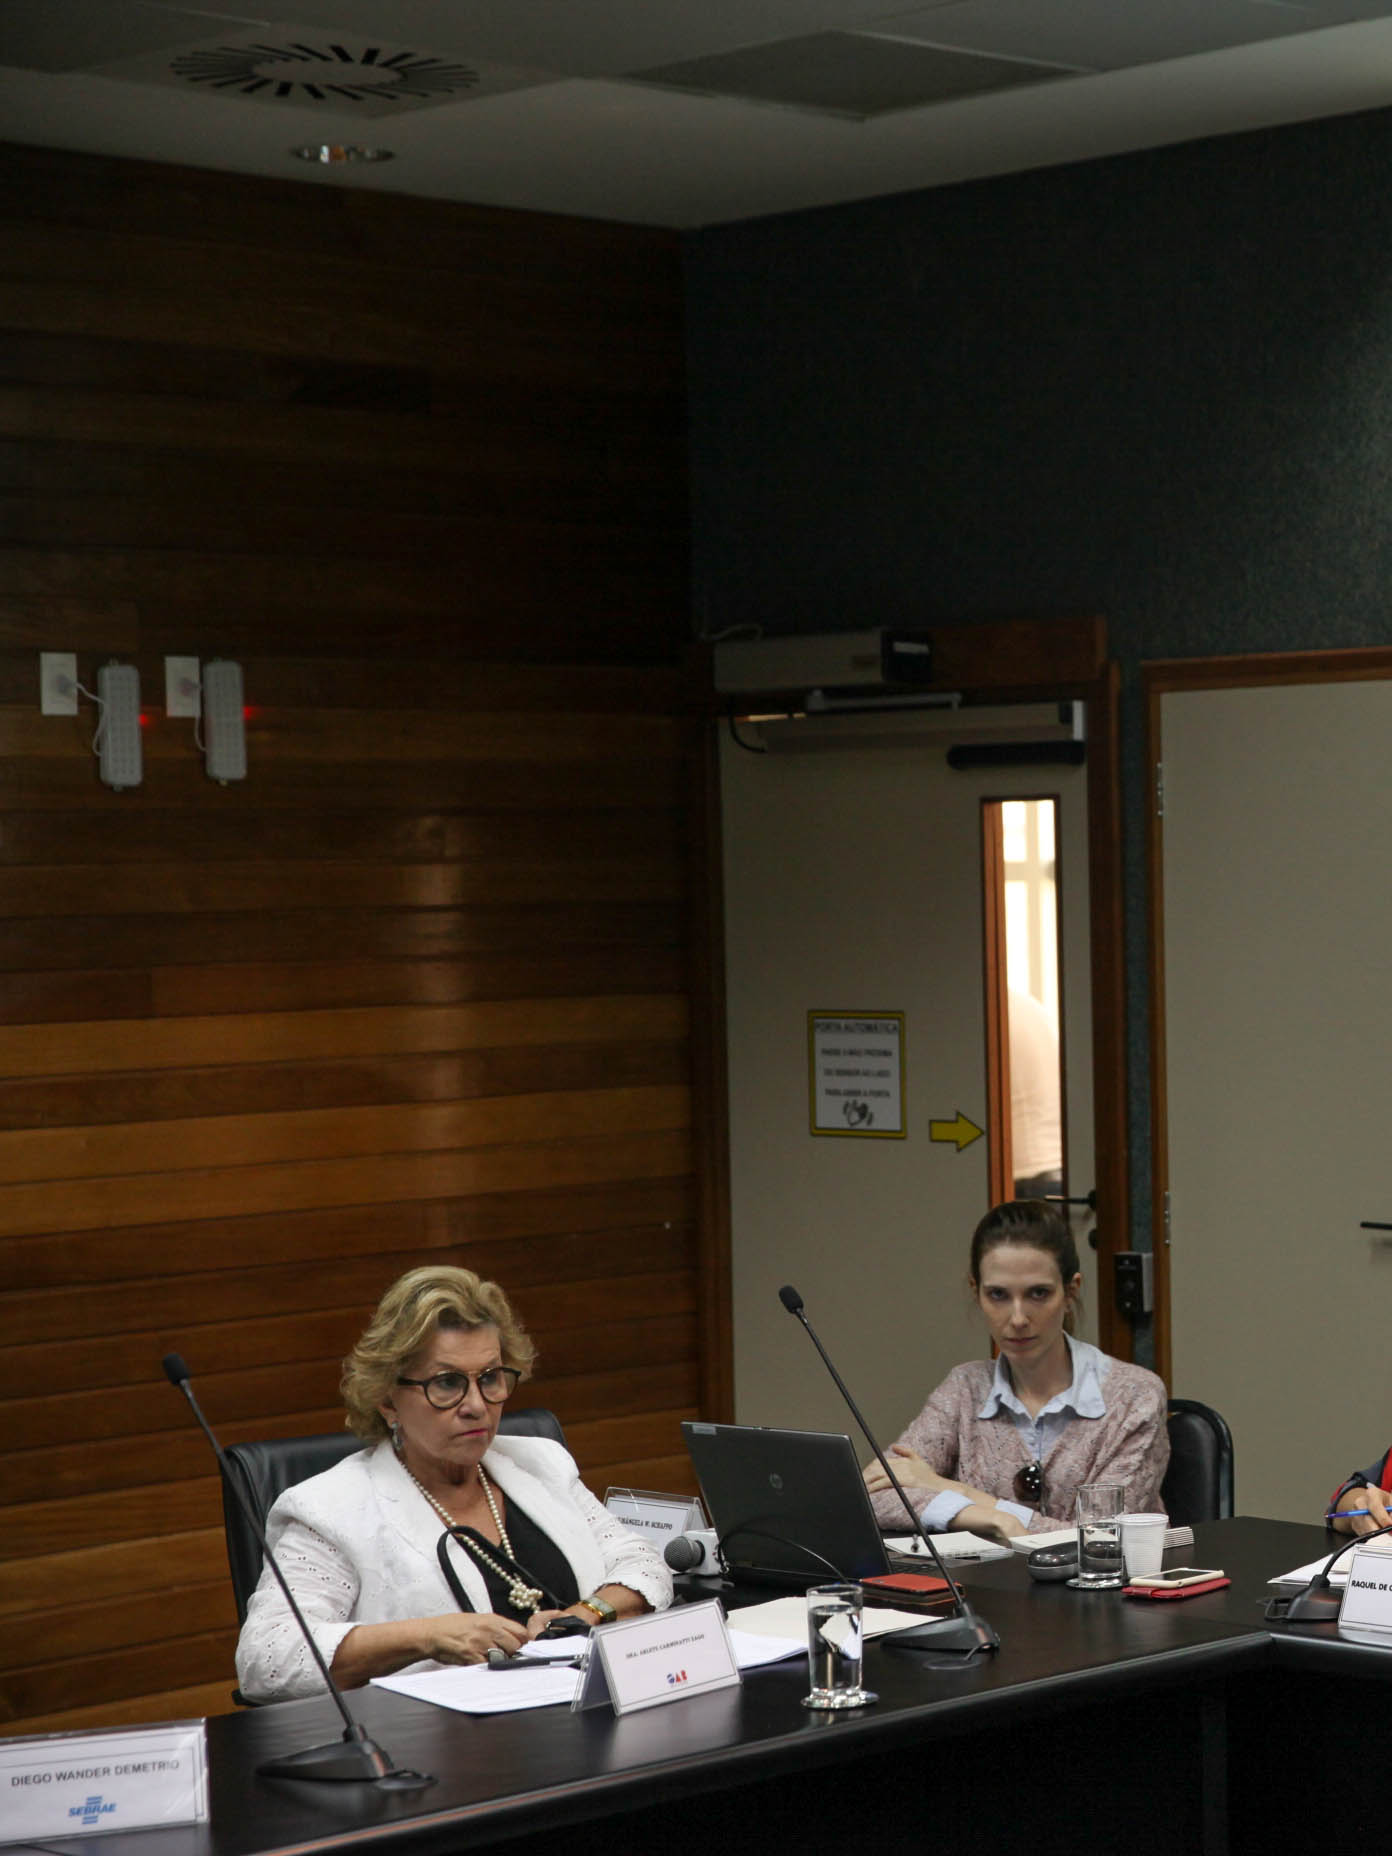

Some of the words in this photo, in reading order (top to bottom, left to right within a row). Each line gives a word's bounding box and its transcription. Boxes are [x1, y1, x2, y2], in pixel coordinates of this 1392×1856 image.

[1351, 1580, 1377, 1590] RAQUEL
[1379, 1583, 1388, 1591] DE
[11, 1774, 52, 1787] DIEGO
[56, 1767, 111, 1782] WANDER
[68, 1802, 117, 1817] SEBRAE
